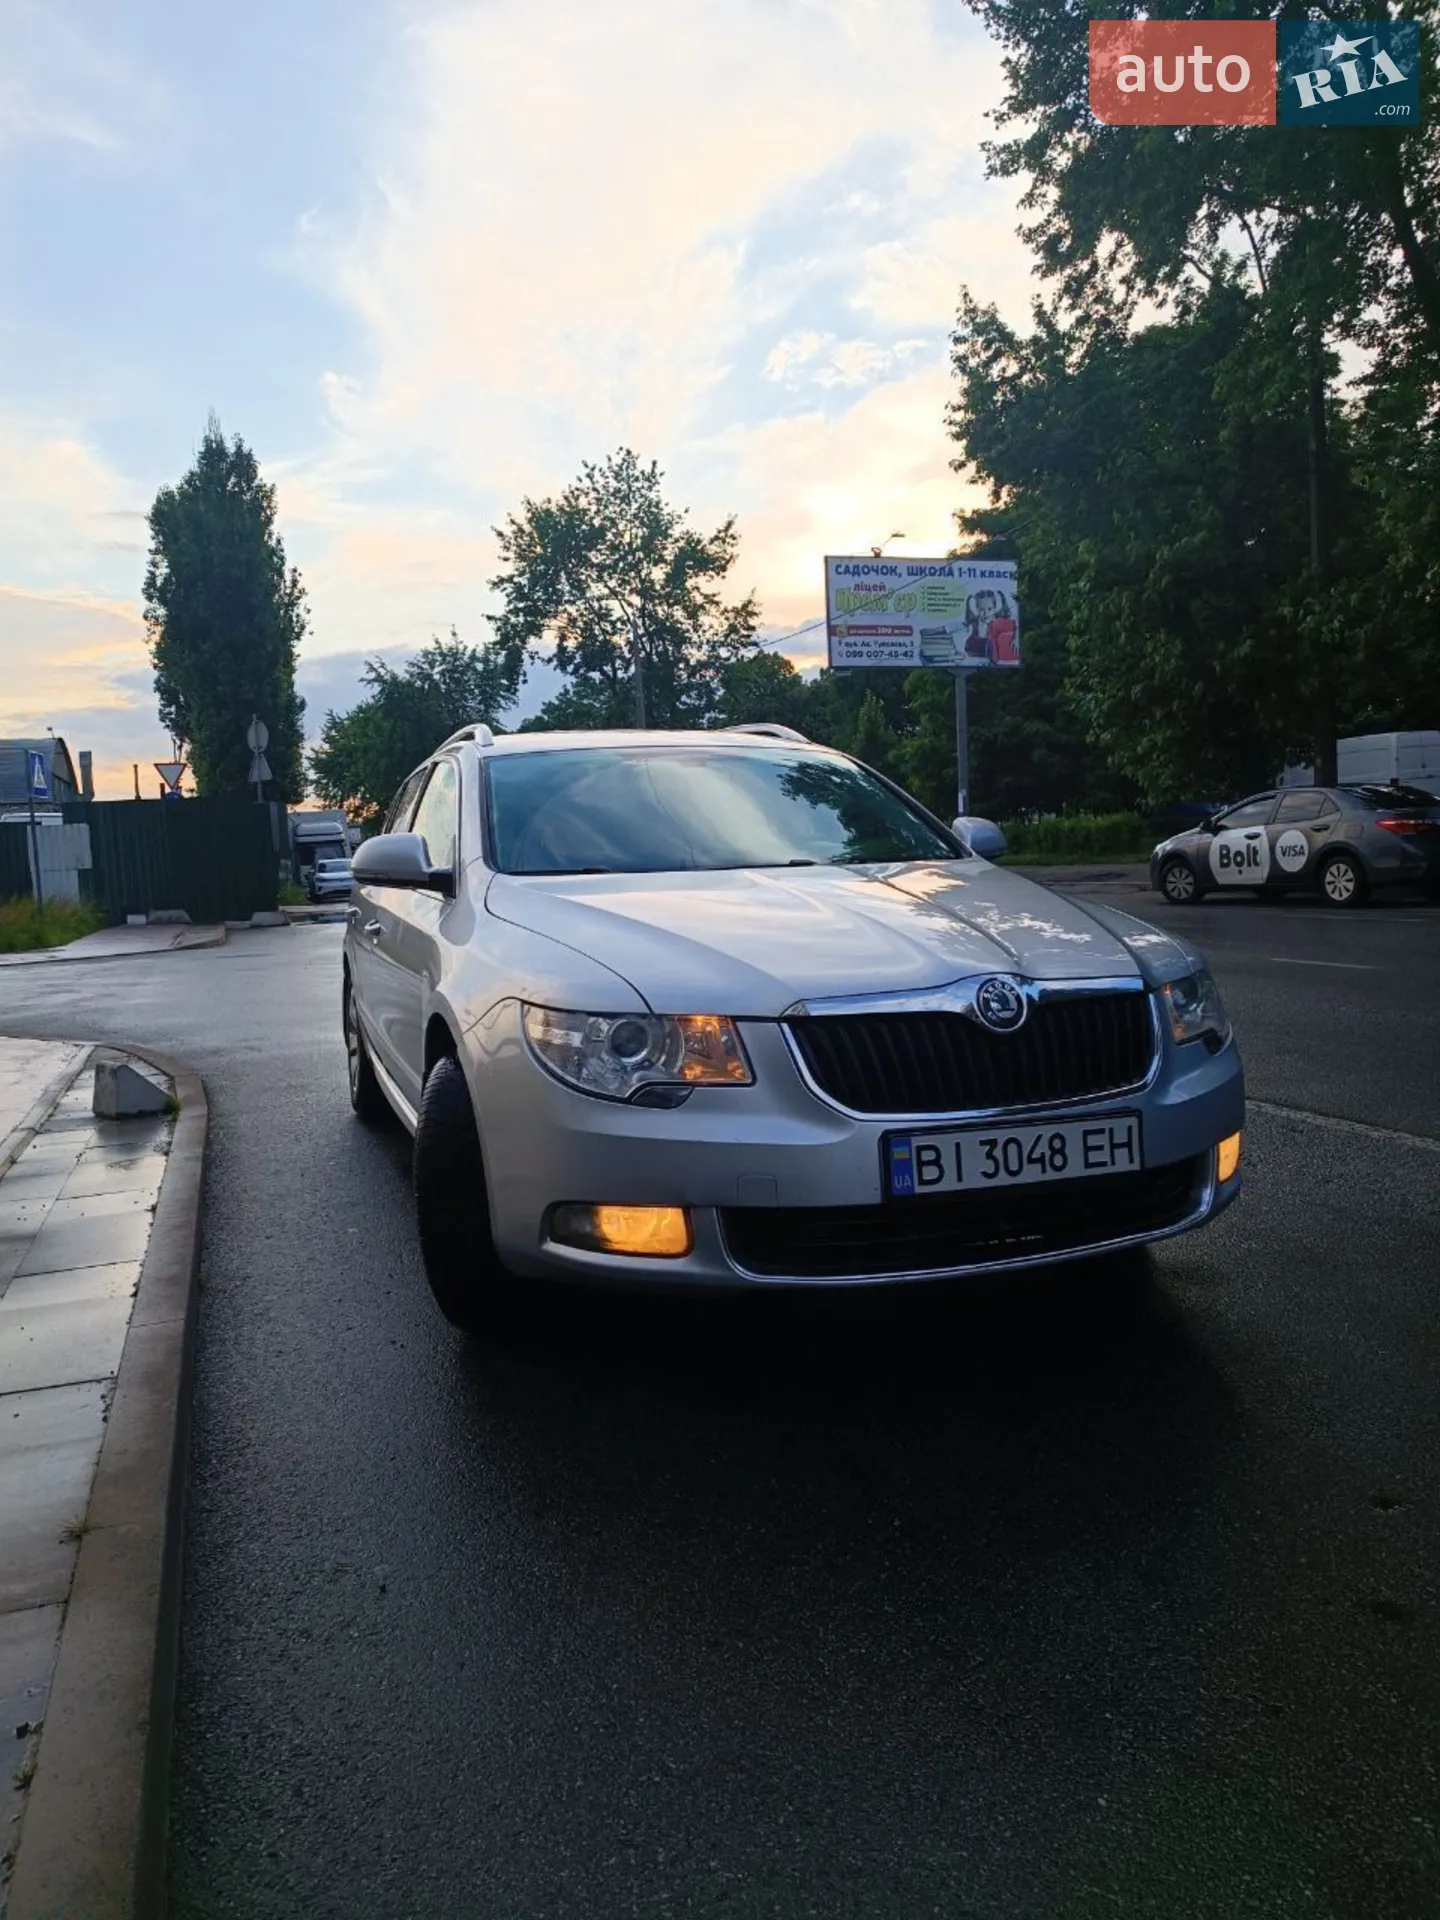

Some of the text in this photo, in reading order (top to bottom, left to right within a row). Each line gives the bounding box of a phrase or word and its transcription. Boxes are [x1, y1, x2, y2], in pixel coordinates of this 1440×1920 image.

[835, 564, 902, 578] САДОЧОК,
[907, 565, 955, 579] ШКОЛА
[853, 581, 886, 593] ліцей
[1219, 843, 1260, 870] Bolt
[1278, 844, 1305, 858] VISA
[915, 1125, 1134, 1186] BI 3048 EH
[893, 1175, 912, 1189] UA
